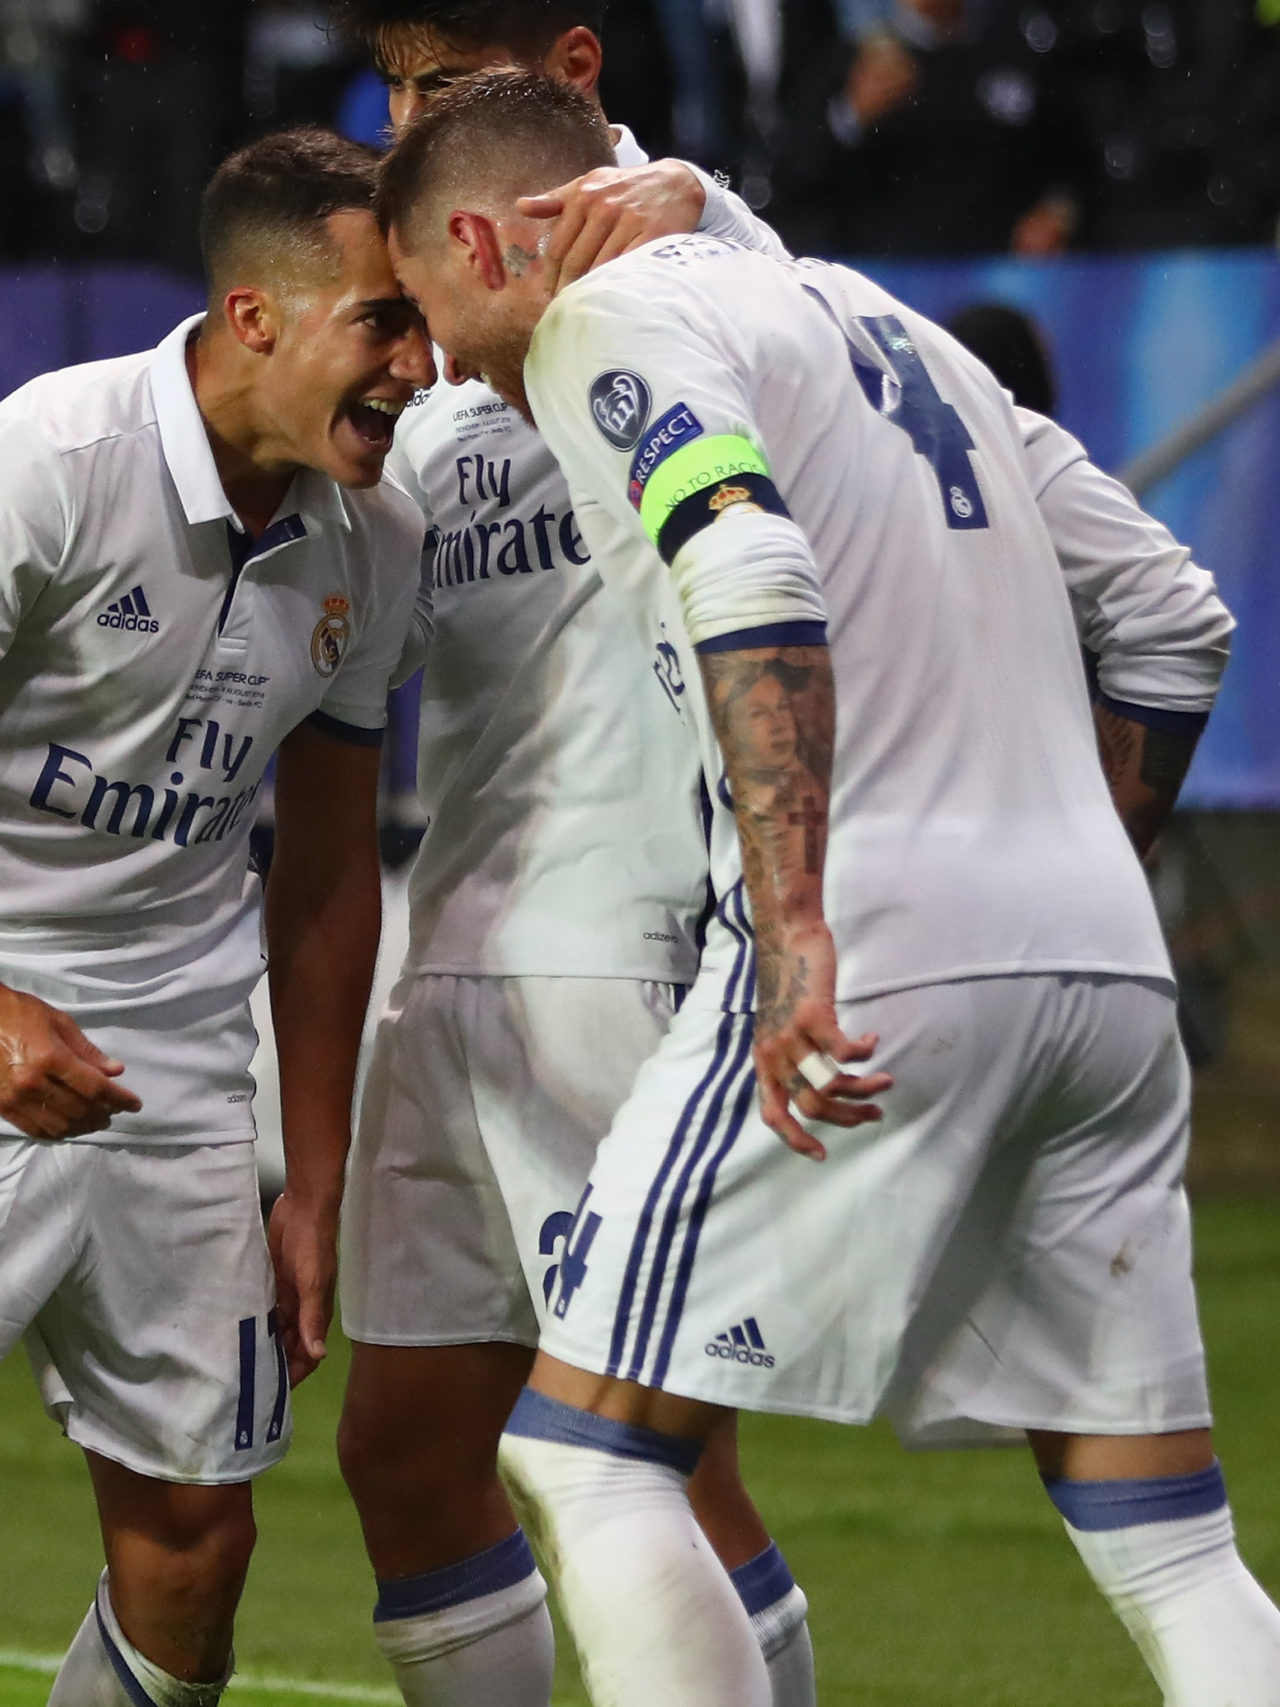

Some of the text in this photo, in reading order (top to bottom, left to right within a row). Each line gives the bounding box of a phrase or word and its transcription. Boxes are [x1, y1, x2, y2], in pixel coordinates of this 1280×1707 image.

[801, 283, 989, 530] 4
[634, 410, 695, 485] RESPECT
[456, 453, 511, 507] Fly
[688, 471, 711, 489] TO
[433, 504, 591, 589] mirate
[97, 612, 160, 633] adidas
[195, 668, 213, 681] EFA
[215, 671, 247, 684] SUPER
[166, 717, 253, 783] Fly
[705, 1340, 776, 1369] adidas
